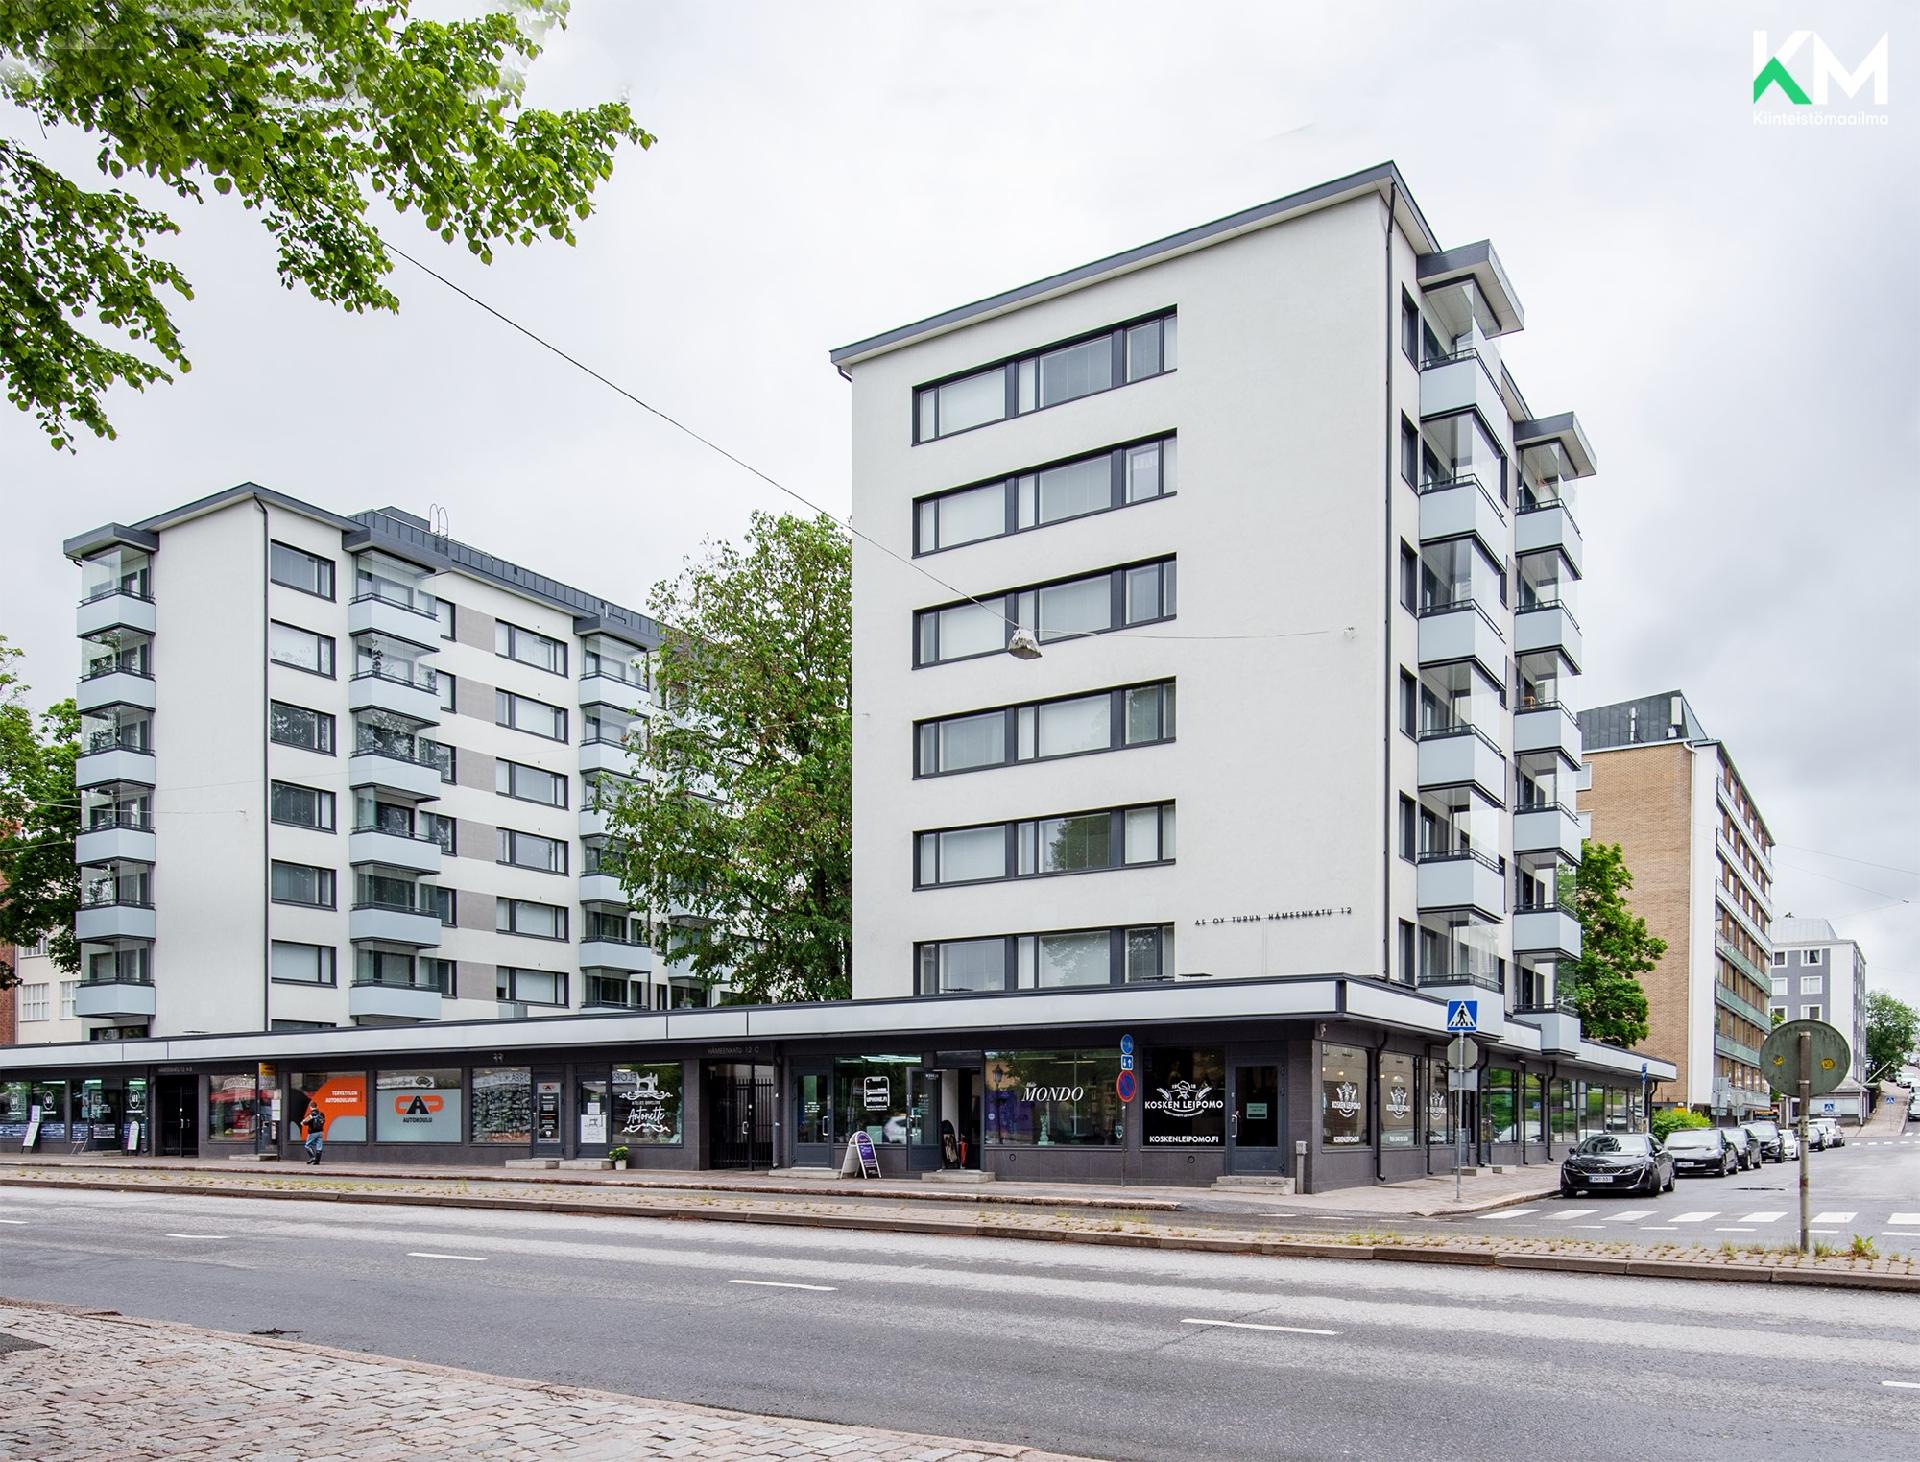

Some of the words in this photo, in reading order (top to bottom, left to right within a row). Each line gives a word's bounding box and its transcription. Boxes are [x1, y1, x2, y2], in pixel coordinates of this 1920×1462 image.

[1232, 915, 1261, 923] TURUN
[1340, 906, 1352, 915] 12
[1021, 1086, 1085, 1102] MONDO
[394, 1095, 445, 1116] CAP
[1144, 1100, 1180, 1109] KOSKEN
[1182, 1100, 1224, 1109] LEIPOMO
[1149, 1135, 1219, 1143] KOSKENLEIPOMO.FI
